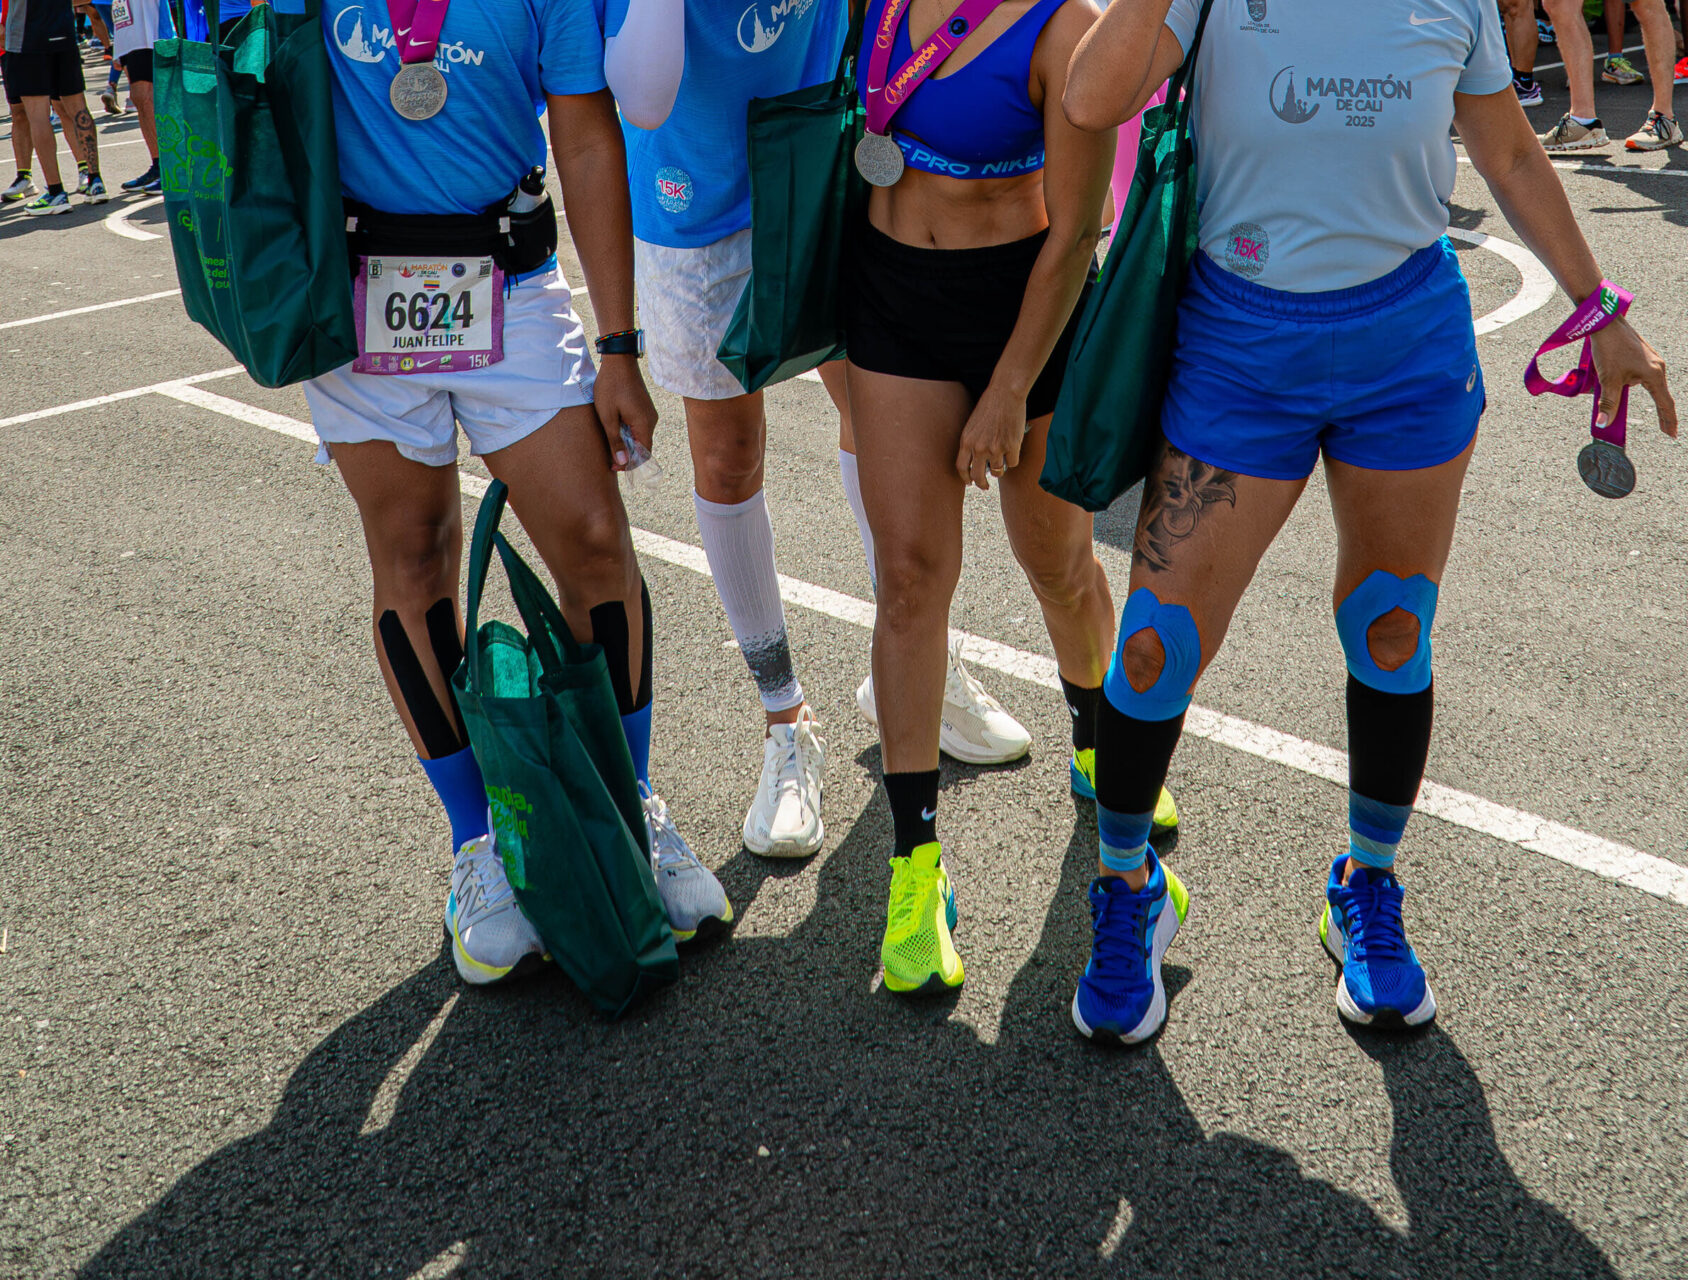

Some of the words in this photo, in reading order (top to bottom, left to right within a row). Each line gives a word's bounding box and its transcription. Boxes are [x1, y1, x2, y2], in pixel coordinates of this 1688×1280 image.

[895, 42, 939, 90] MARATÓN
[1306, 74, 1412, 100] MARATÓN
[1336, 99, 1353, 111] DE
[1355, 100, 1383, 112] CALI
[1345, 115, 1376, 127] 2025
[910, 148, 970, 175] PRO
[981, 154, 1038, 175] NIKE
[658, 179, 686, 200] 15K
[1233, 236, 1264, 261] 15K
[411, 262, 448, 272] MARATÓN
[385, 290, 474, 332] 6624
[392, 335, 423, 349] JUAN
[426, 334, 465, 347] FELIPE
[469, 354, 491, 369] 15K
